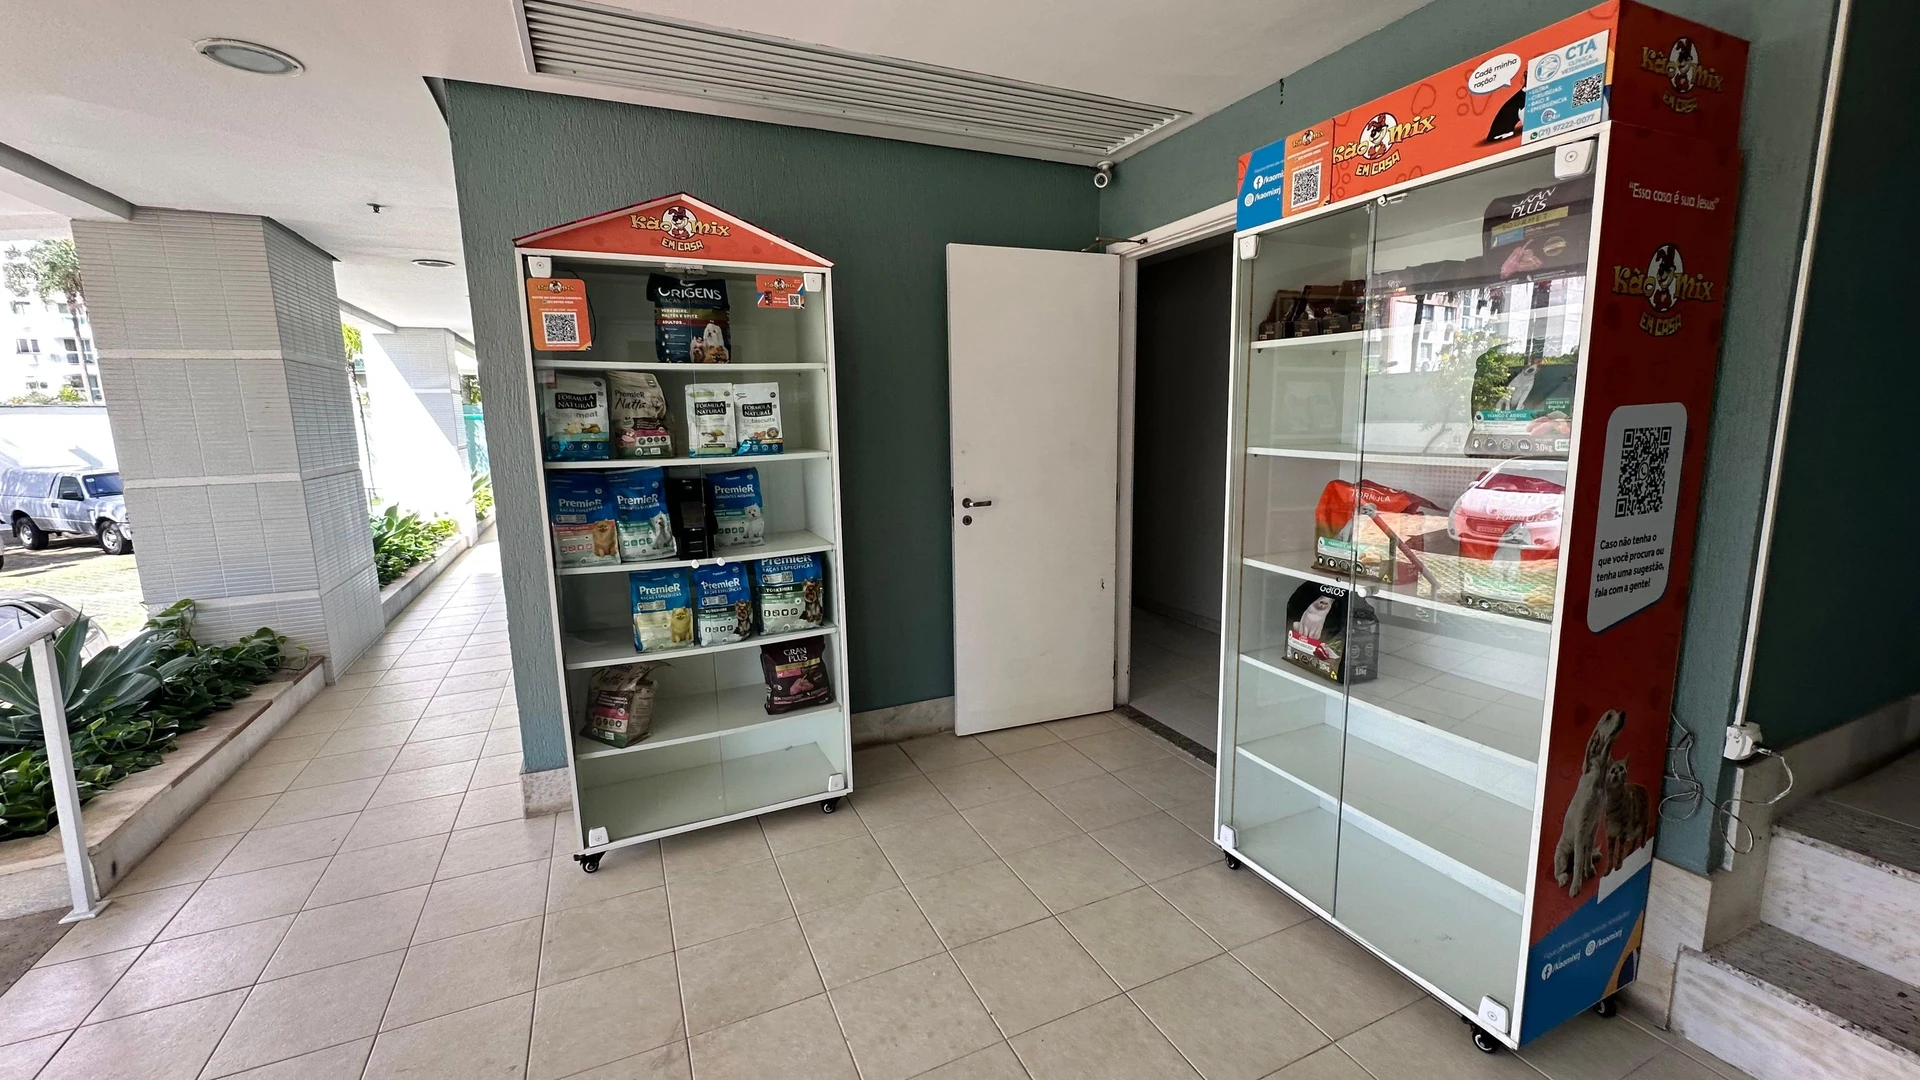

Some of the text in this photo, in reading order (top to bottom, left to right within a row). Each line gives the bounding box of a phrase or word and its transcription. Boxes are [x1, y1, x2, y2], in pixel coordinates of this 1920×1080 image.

[1566, 39, 1596, 60] CTA
[1474, 58, 1517, 79] Cadê minha
[1641, 46, 1677, 77] Kão
[1474, 74, 1496, 88] ração?
[1538, 114, 1595, 138] (21) 97222-0077
[1333, 141, 1369, 164] Kão
[1389, 116, 1436, 144] mix
[1356, 150, 1400, 176] EM CASA
[1511, 198, 1548, 218] PLUS
[1653, 190, 1672, 203] casa
[1674, 190, 1680, 204] é
[1681, 195, 1695, 206] sua
[630, 214, 731, 236] Kão mix
[662, 238, 704, 252] EM CASA
[1612, 266, 1714, 300] Kão mix
[1640, 312, 1682, 336] EM CASA
[1600, 540, 1618, 550] Caso
[1618, 537, 1632, 546] não
[1633, 534, 1651, 544] tenha
[1598, 558, 1612, 568] que
[1612, 552, 1628, 564] você
[1629, 550, 1655, 562] procura
[1596, 562, 1664, 582] tenha uma sugestão,
[1594, 588, 1608, 598] fala
[1609, 586, 1623, 594] com
[1630, 578, 1651, 593] gente!
[784, 647, 808, 656] GRAN
[788, 654, 808, 662] PLUS
